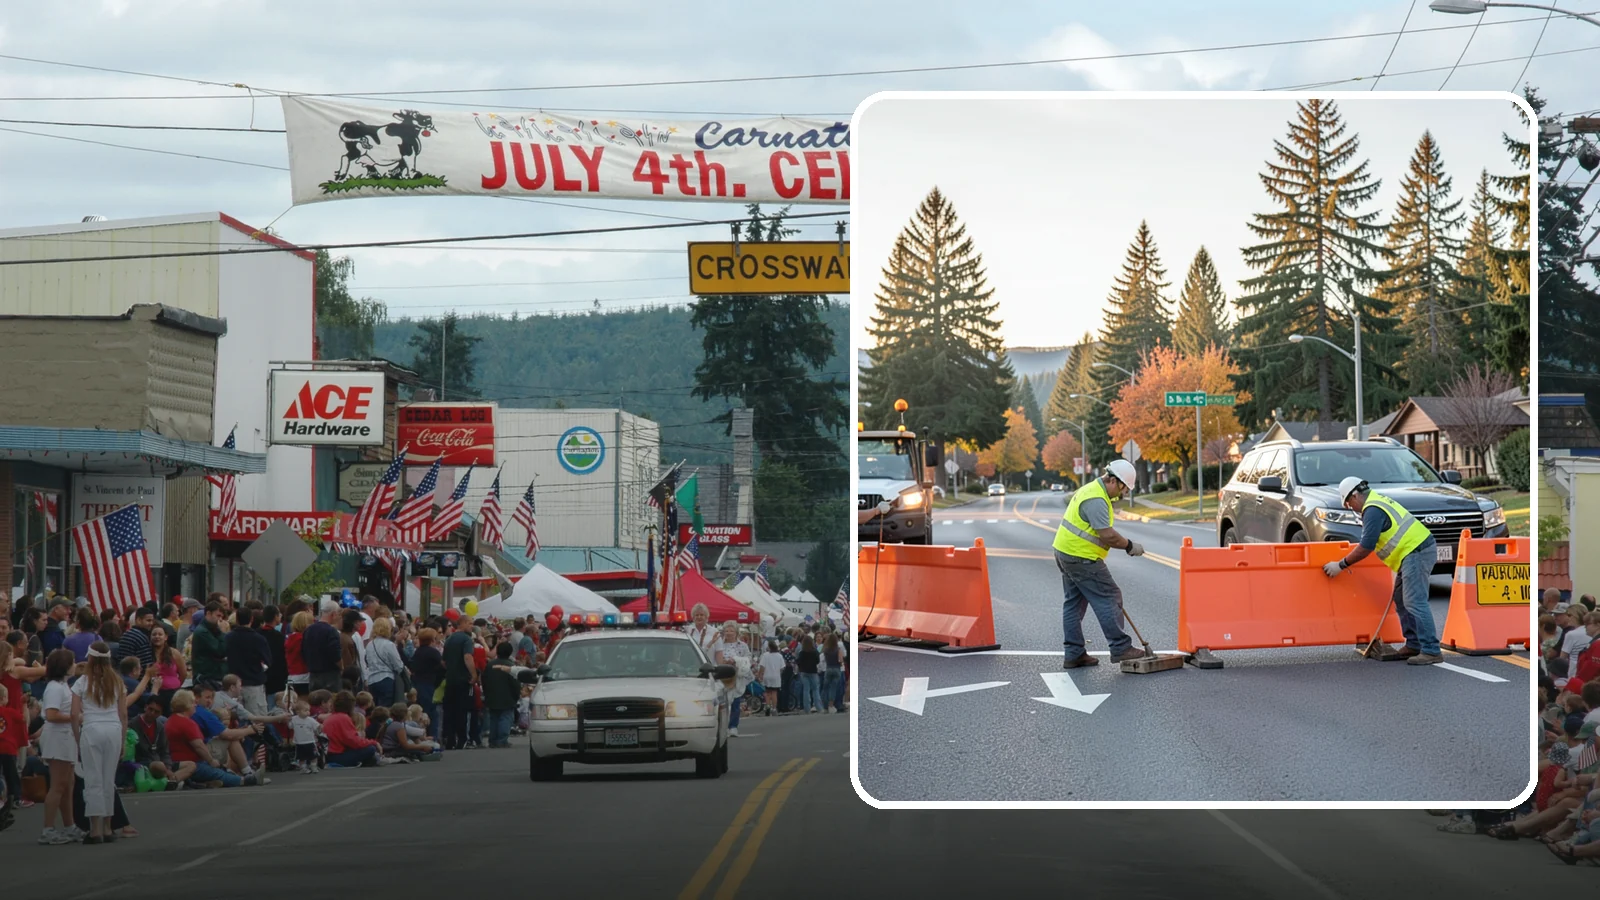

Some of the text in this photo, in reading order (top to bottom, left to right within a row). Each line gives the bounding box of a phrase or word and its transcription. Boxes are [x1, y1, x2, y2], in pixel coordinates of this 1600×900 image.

[481, 140, 605, 192] JULY
[632, 150, 746, 198] 4th.
[697, 254, 850, 280] CROSSWA
[283, 380, 373, 420] ACE
[405, 409, 485, 422] CEDAR LOG
[283, 421, 370, 436] Hardware
[416, 428, 477, 447] Coca-Cola
[353, 467, 384, 480] Simpl
[96, 485, 124, 495] Vincent
[126, 486, 136, 495] de
[138, 486, 155, 495] Paul
[688, 526, 741, 535] CRNATION
[699, 535, 730, 543] GLASS
